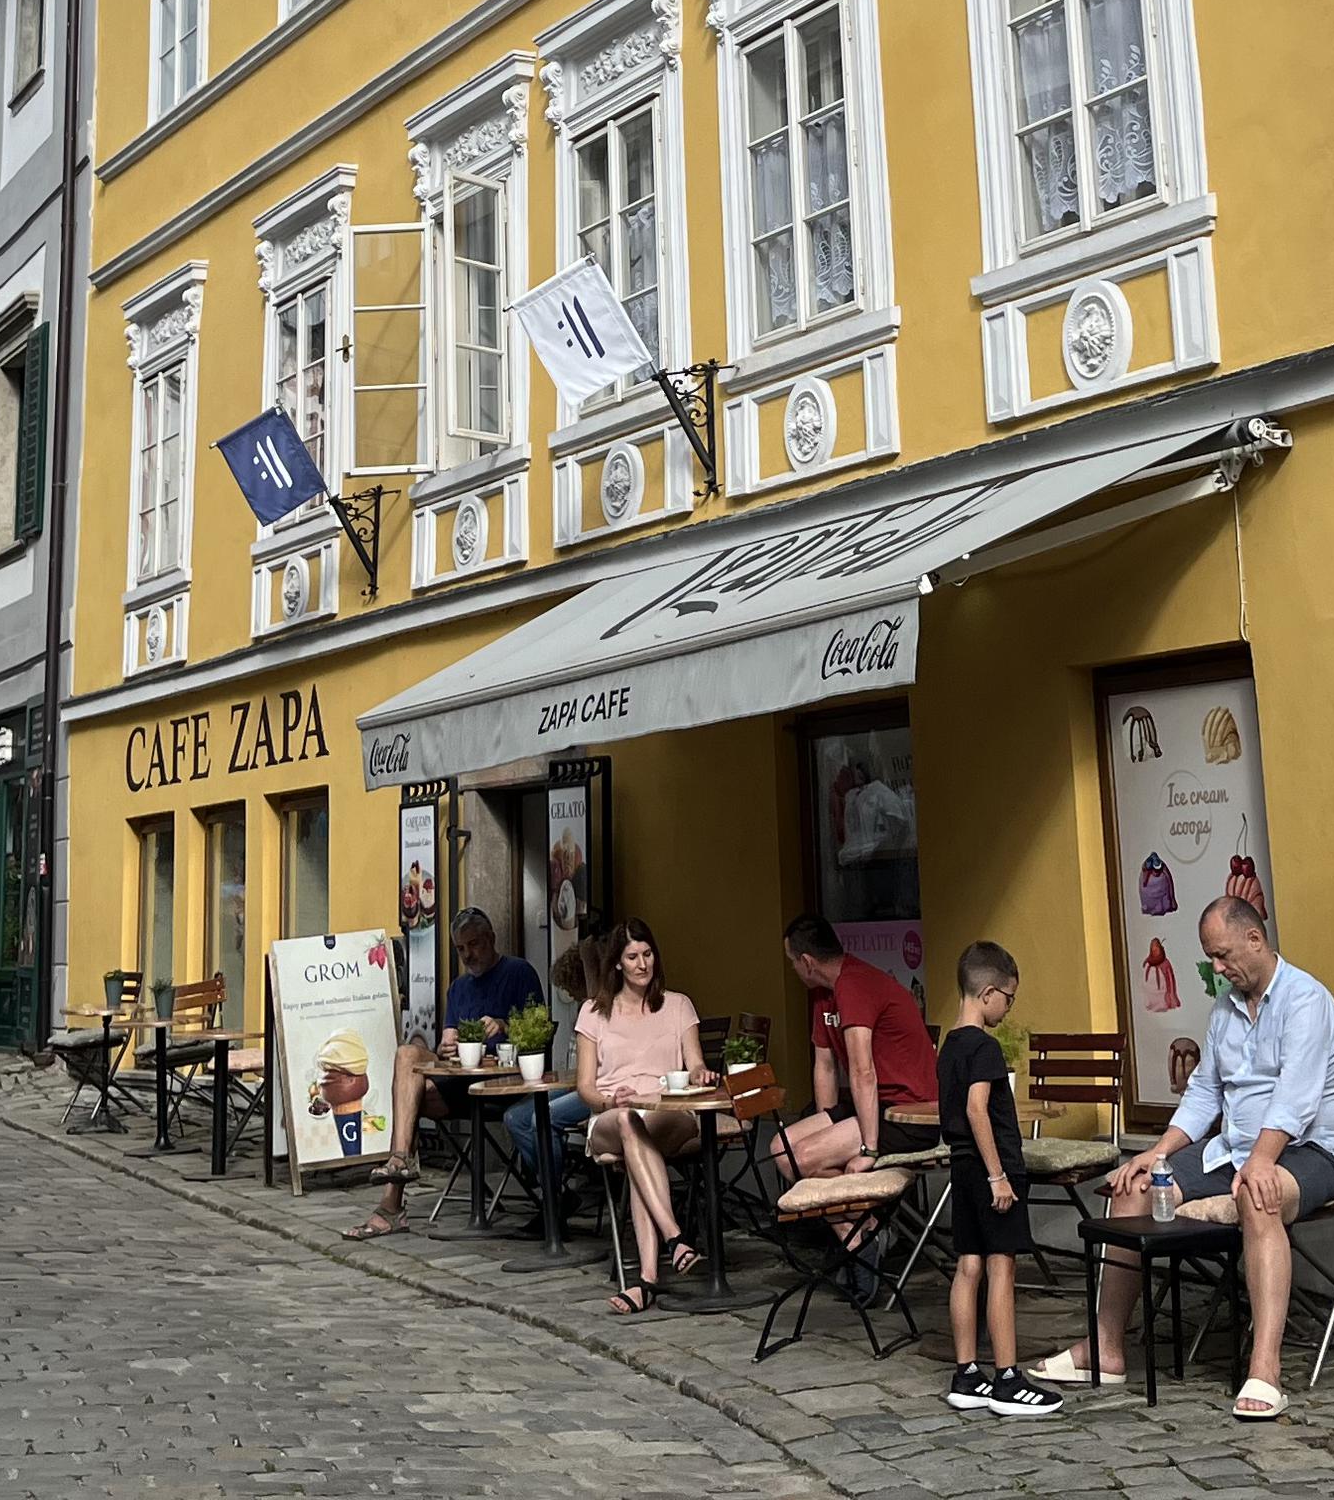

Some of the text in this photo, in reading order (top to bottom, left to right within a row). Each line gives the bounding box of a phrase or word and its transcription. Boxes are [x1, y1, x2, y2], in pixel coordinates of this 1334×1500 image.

[537, 686, 631, 736] ZAPA CAFE
[125, 711, 211, 793] CAFE
[228, 683, 330, 774] ZAPA
[1167, 782, 1229, 808] Ice cream
[550, 800, 585, 820] GELATO
[1169, 820, 1212, 846] scoops
[304, 959, 361, 983] GROM
[342, 1121, 358, 1142] G
